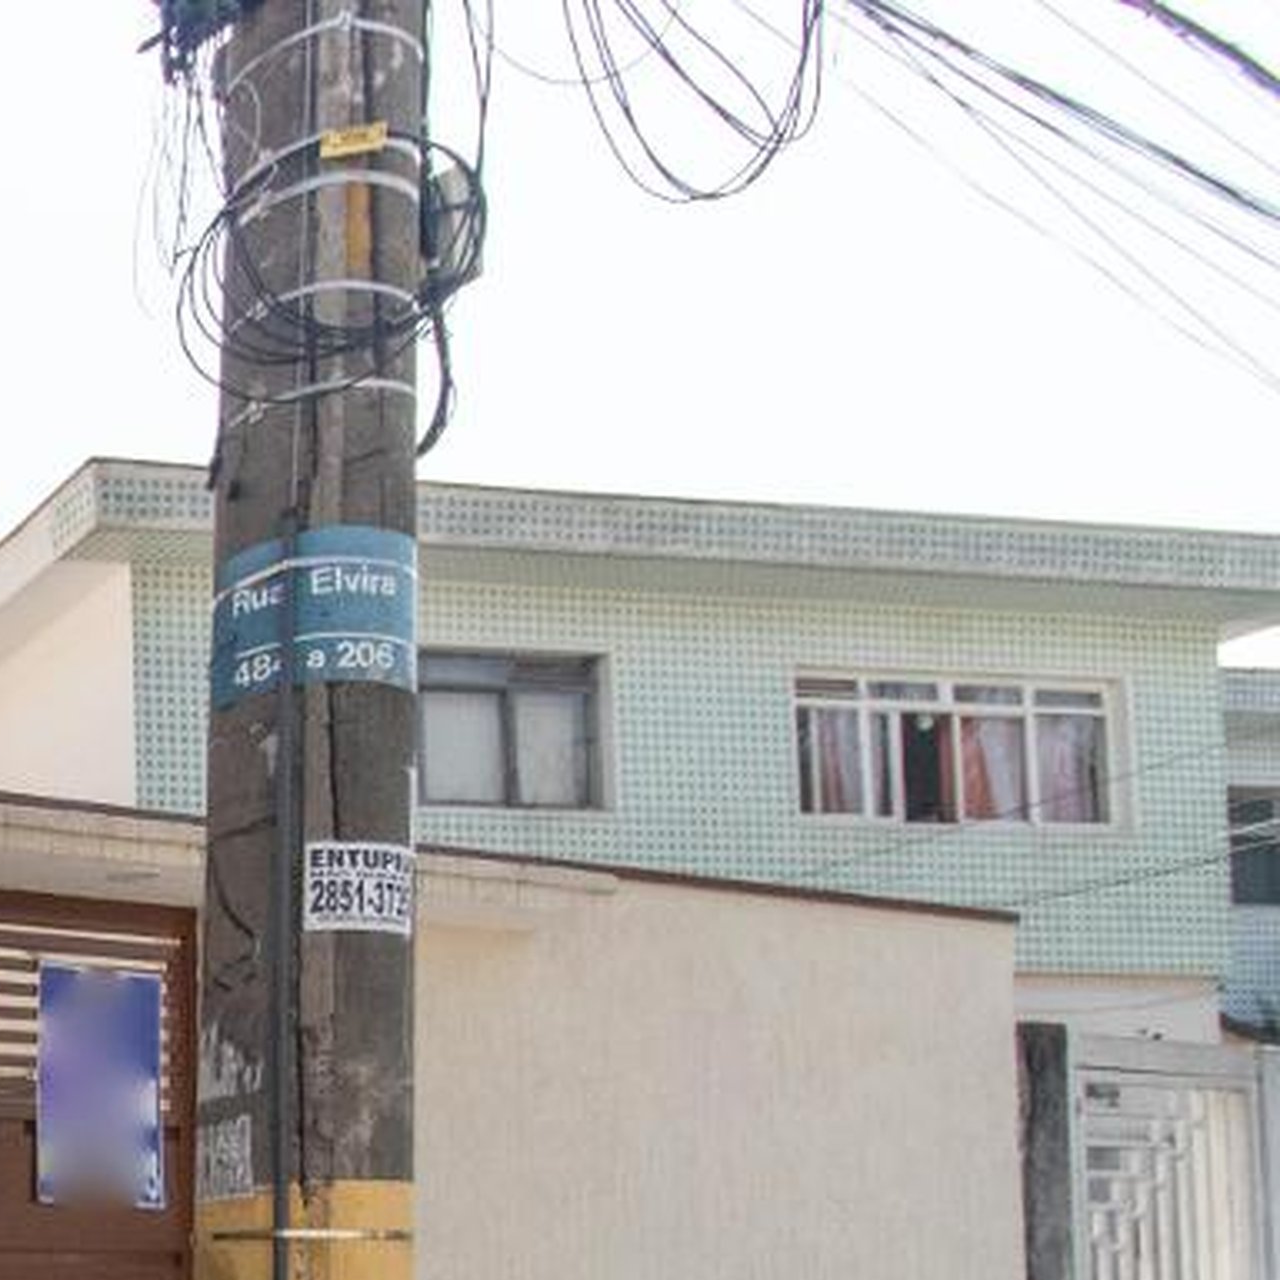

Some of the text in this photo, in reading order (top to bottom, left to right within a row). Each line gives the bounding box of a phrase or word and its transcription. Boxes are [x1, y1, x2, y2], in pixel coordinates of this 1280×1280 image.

[311, 564, 396, 595] Elvira
[306, 648, 325, 668] a
[336, 639, 395, 668] 206
